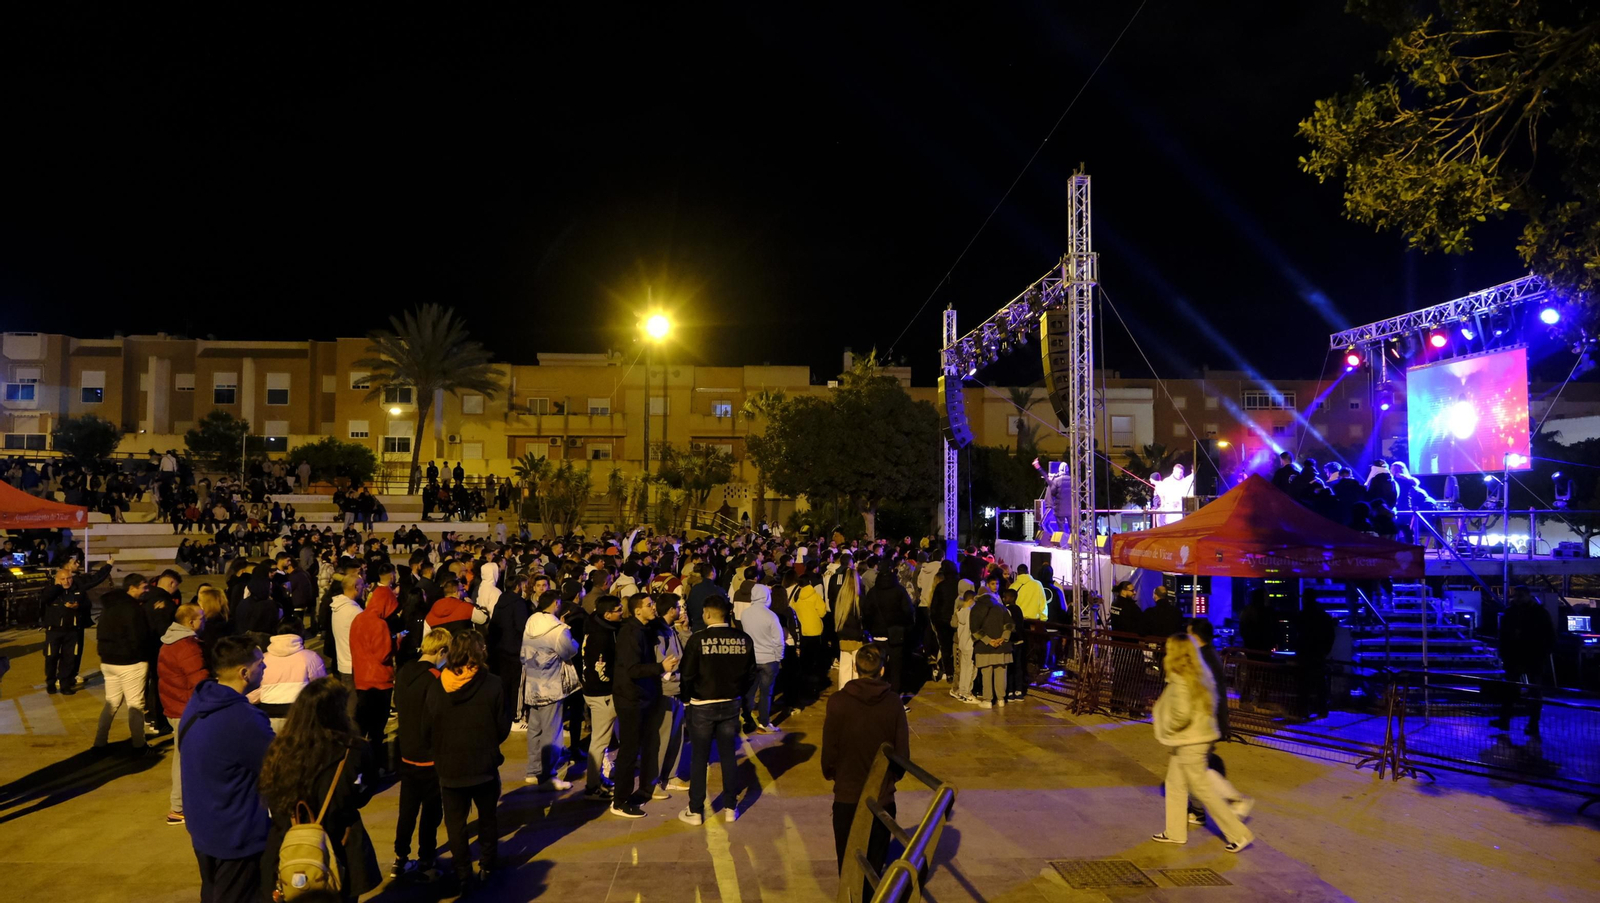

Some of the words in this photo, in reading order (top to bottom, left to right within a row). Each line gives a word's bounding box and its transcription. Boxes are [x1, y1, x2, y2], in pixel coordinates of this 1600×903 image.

[1152, 548, 1158, 558] de
[1327, 555, 1341, 567] de
[701, 637, 718, 645] LAS
[719, 637, 746, 645] VEGAS
[702, 645, 747, 655] RAIDERS
